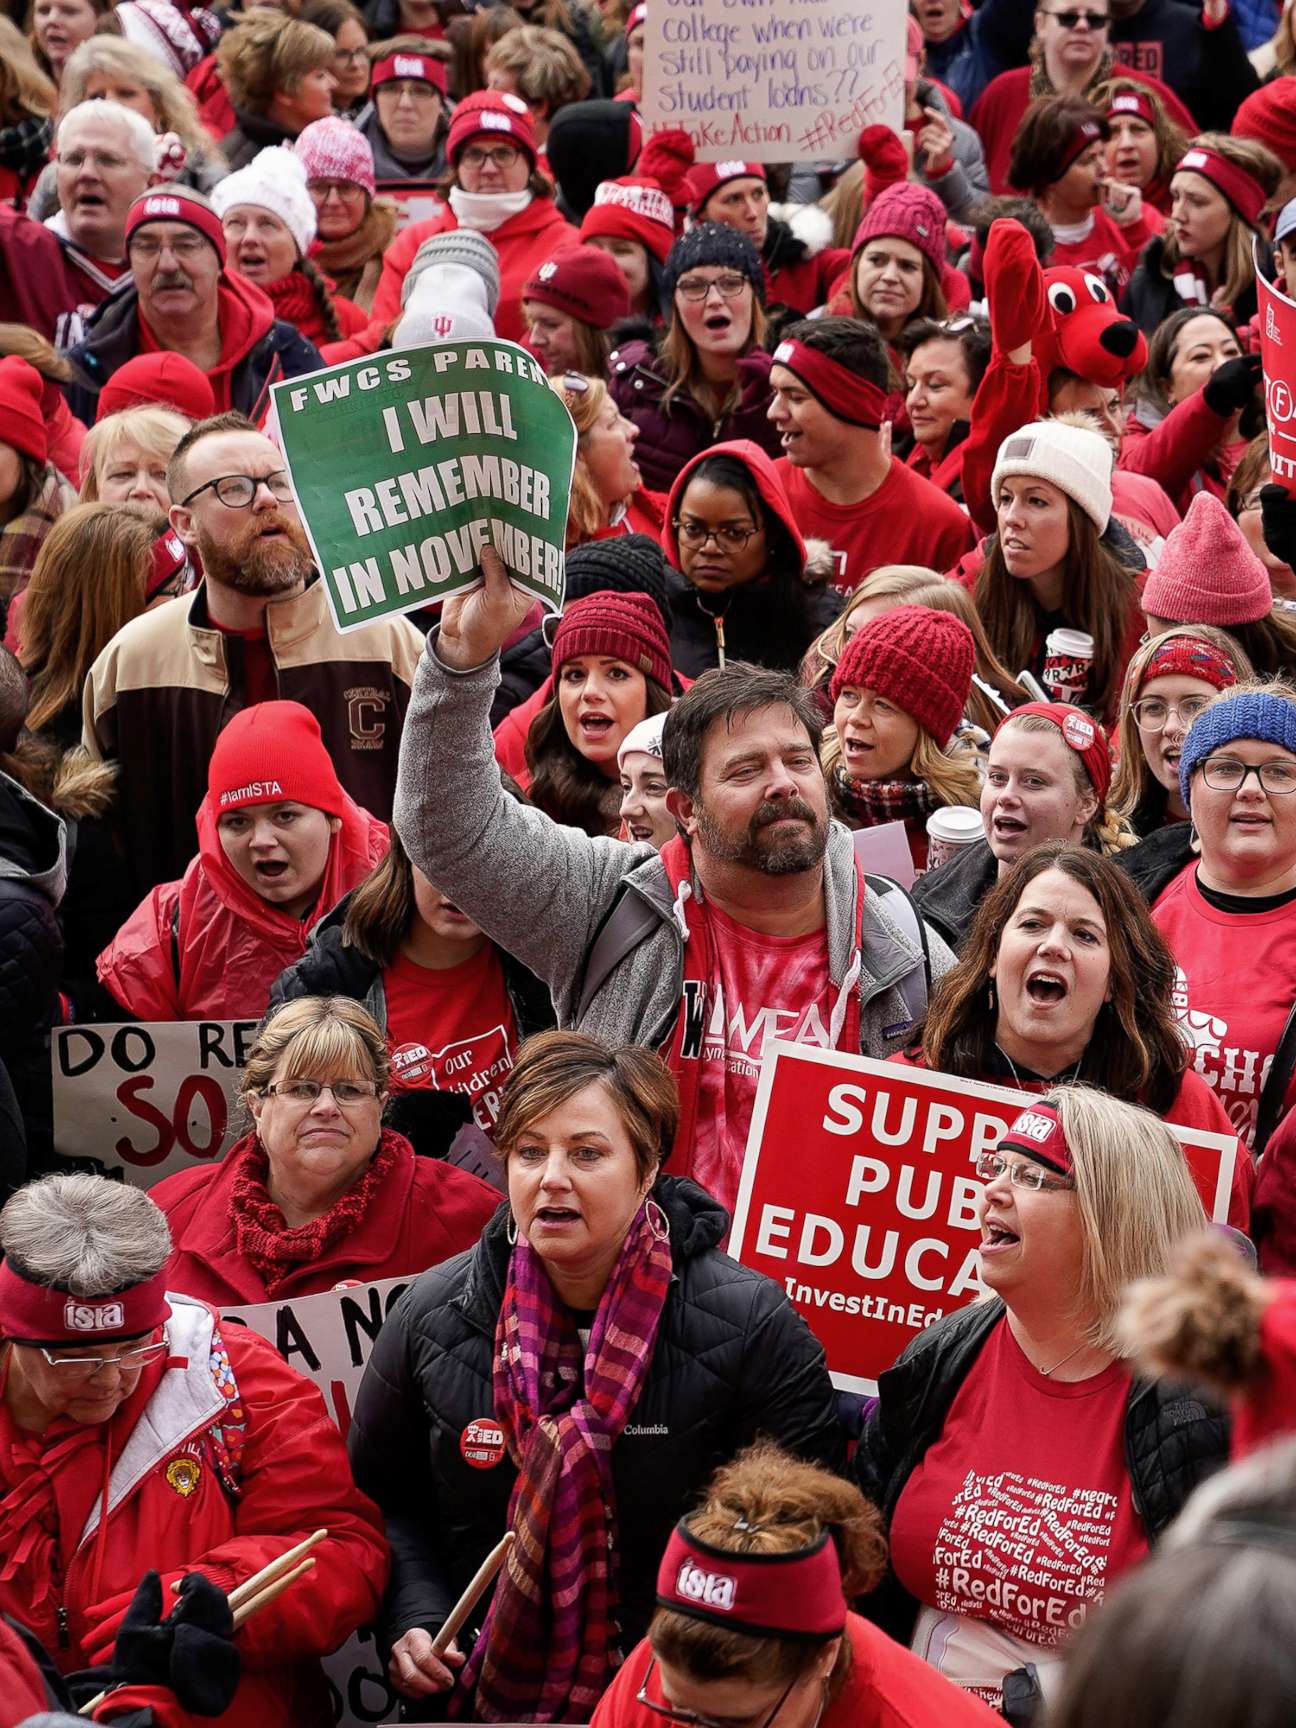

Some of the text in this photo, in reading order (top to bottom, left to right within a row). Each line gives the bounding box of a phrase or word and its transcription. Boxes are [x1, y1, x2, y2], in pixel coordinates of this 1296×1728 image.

[663, 13, 741, 54] college
[752, 14, 812, 43] when
[659, 38, 884, 82] still paying on our
[658, 80, 750, 113] student
[289, 358, 413, 412] FWCS
[382, 390, 518, 454] I WILL
[343, 454, 551, 537] REMEMBER
[332, 517, 564, 614] IN NOVEMBER!
[348, 696, 386, 741] C
[220, 781, 283, 806] #IamISTA
[58, 1025, 156, 1077] DO
[444, 1049, 473, 1076] Our
[115, 1074, 228, 1168] SO
[63, 1297, 124, 1331] ista
[624, 1423, 669, 1436] Columbia
[954, 1504, 1041, 1537] #RedForEd
[1035, 1492, 1103, 1520] #RedForEd
[938, 1526, 970, 1549] ForEd
[959, 1520, 1035, 1565] #RedForEd
[1040, 1507, 1096, 1569] #RedForEd
[1066, 1519, 1112, 1537] #RedForEd
[932, 1546, 983, 1570] ForEd
[1036, 1553, 1083, 1576] #RedForEd
[677, 1562, 737, 1610] ista
[935, 1566, 1087, 1631] #RedForEd
[1009, 1564, 1086, 1597] #RedForEd
